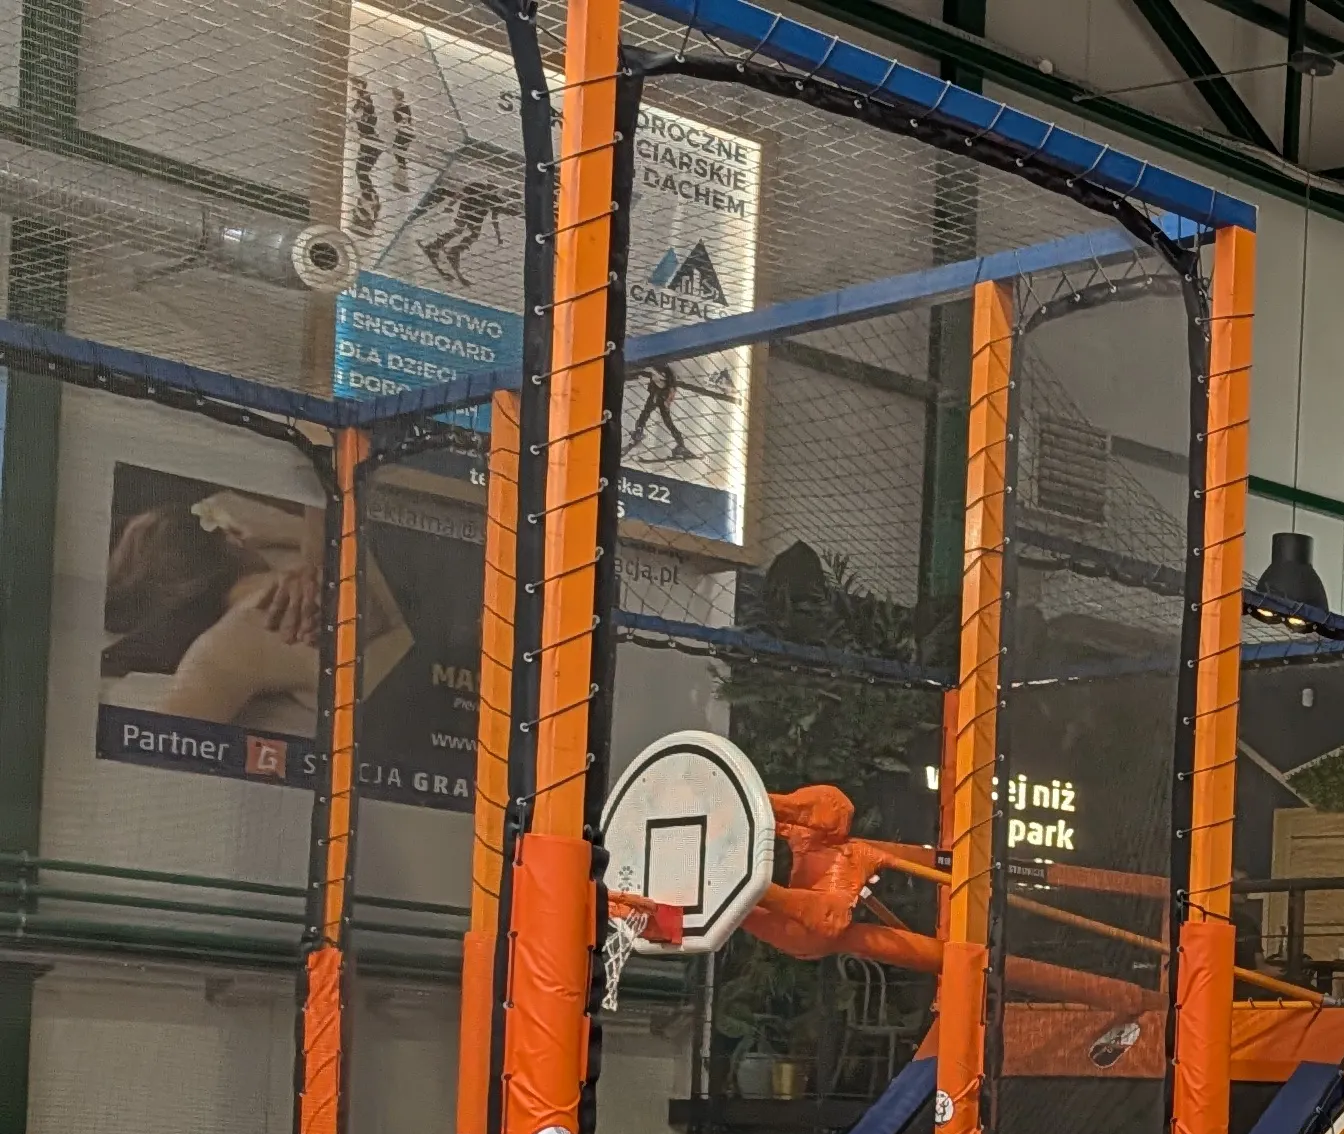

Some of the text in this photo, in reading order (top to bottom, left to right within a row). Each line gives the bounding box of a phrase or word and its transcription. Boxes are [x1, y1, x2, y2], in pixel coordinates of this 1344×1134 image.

[353, 311, 496, 363] SNOWBOARD
[648, 484, 671, 504] 22
[123, 724, 230, 763] Partner
[413, 771, 470, 799] GRA
[1032, 779, 1076, 812] niż
[1008, 818, 1075, 851] park
